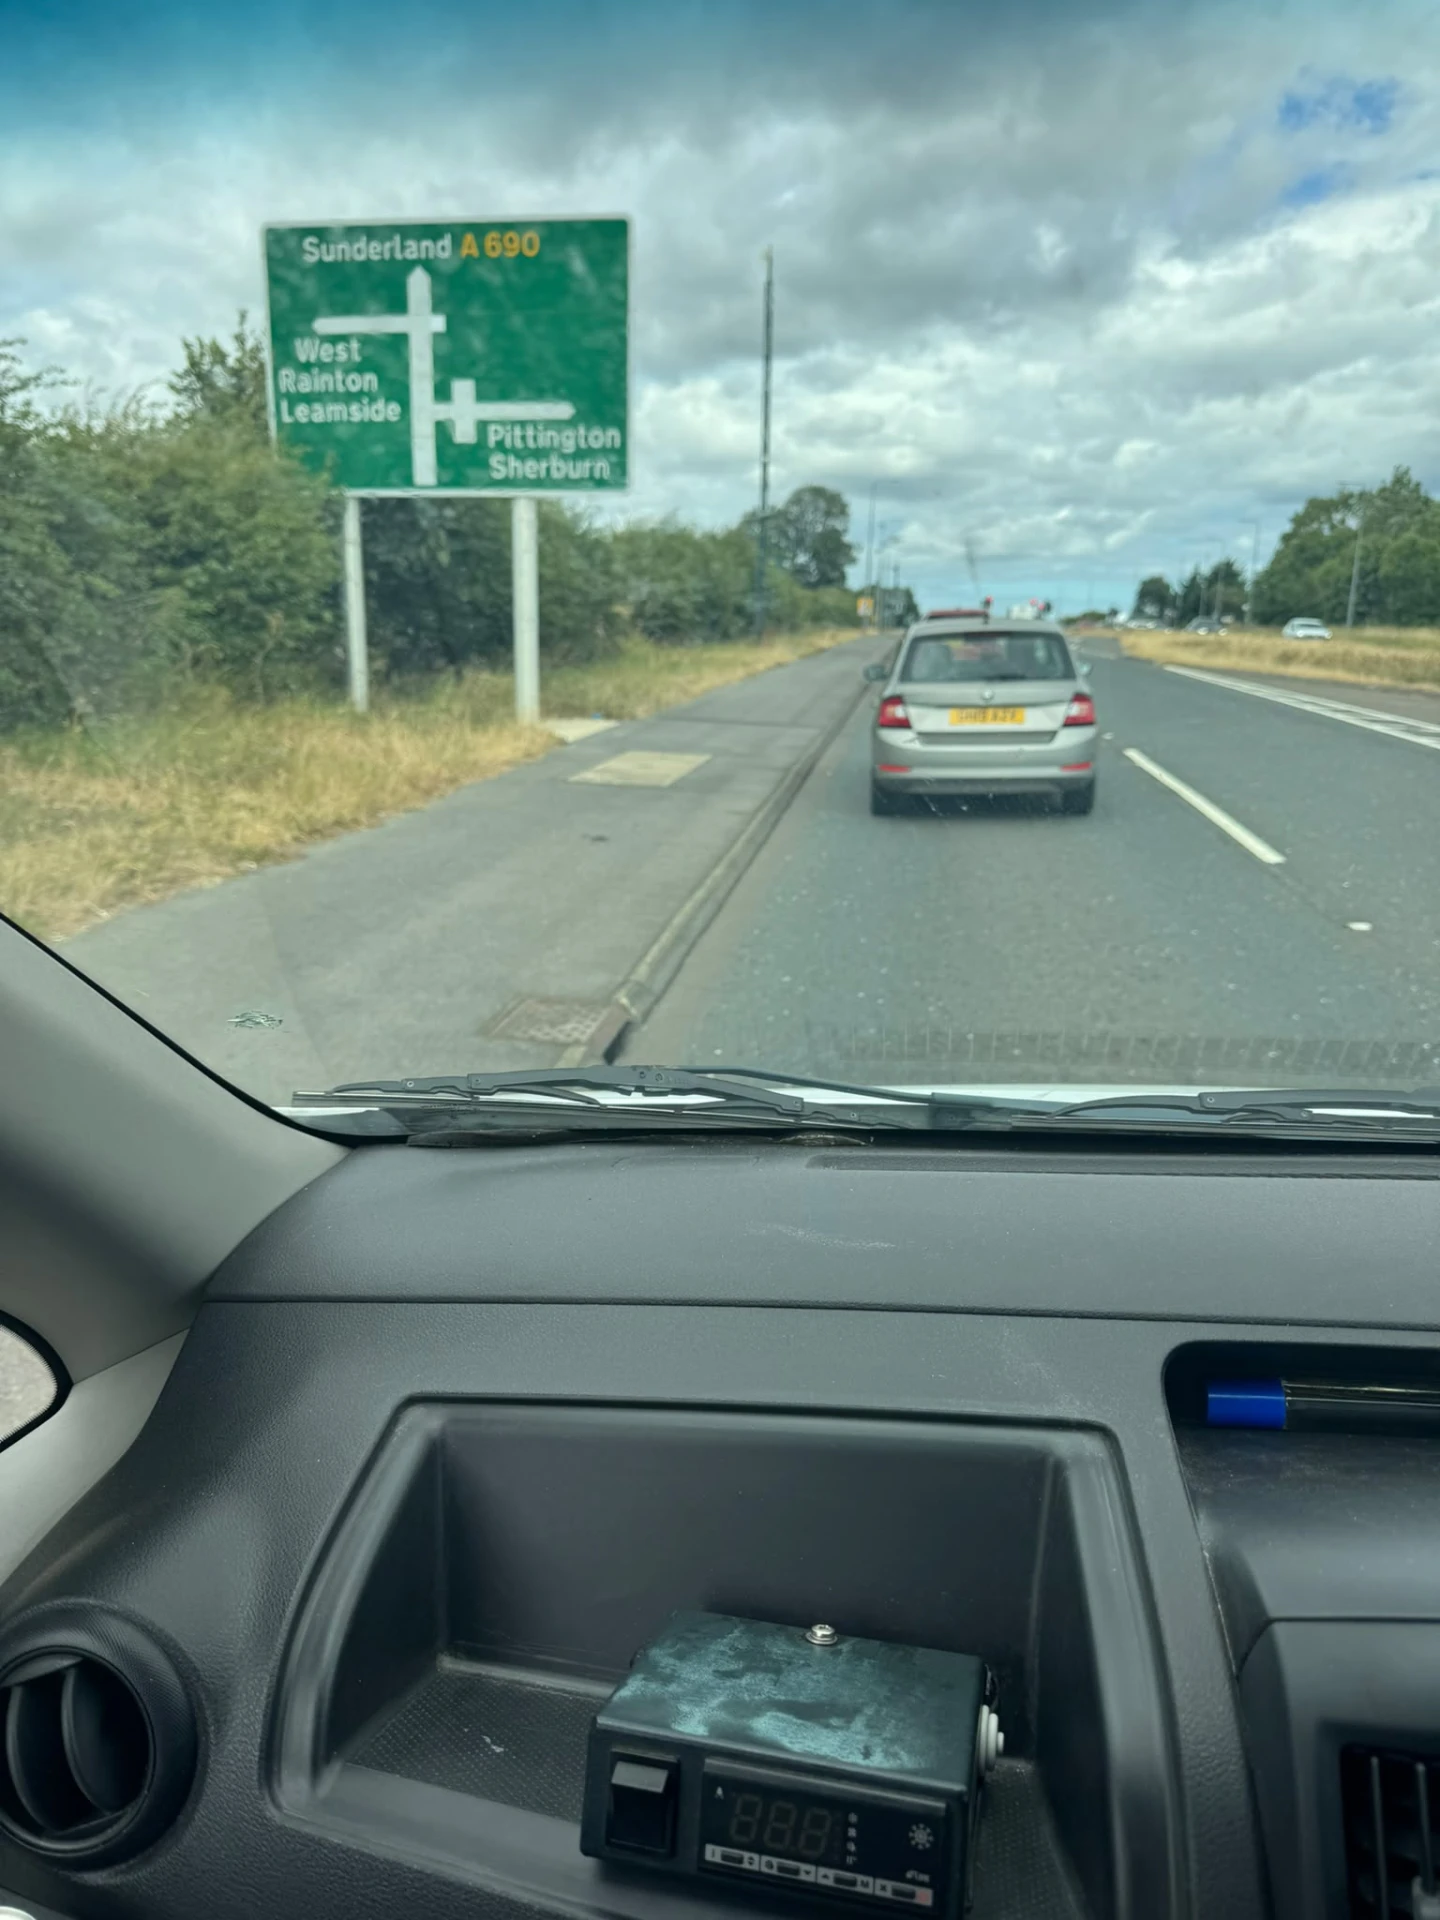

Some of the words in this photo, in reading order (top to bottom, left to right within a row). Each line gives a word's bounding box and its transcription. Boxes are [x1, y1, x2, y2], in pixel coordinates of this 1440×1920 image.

[301, 232, 452, 263] Sunderland
[460, 232, 479, 258] A
[484, 230, 541, 258] 690
[294, 337, 362, 363] West
[278, 367, 378, 393] Rainton
[279, 397, 402, 424] Leamside
[486, 423, 622, 454] Pittington
[488, 452, 611, 481] Sherburn
